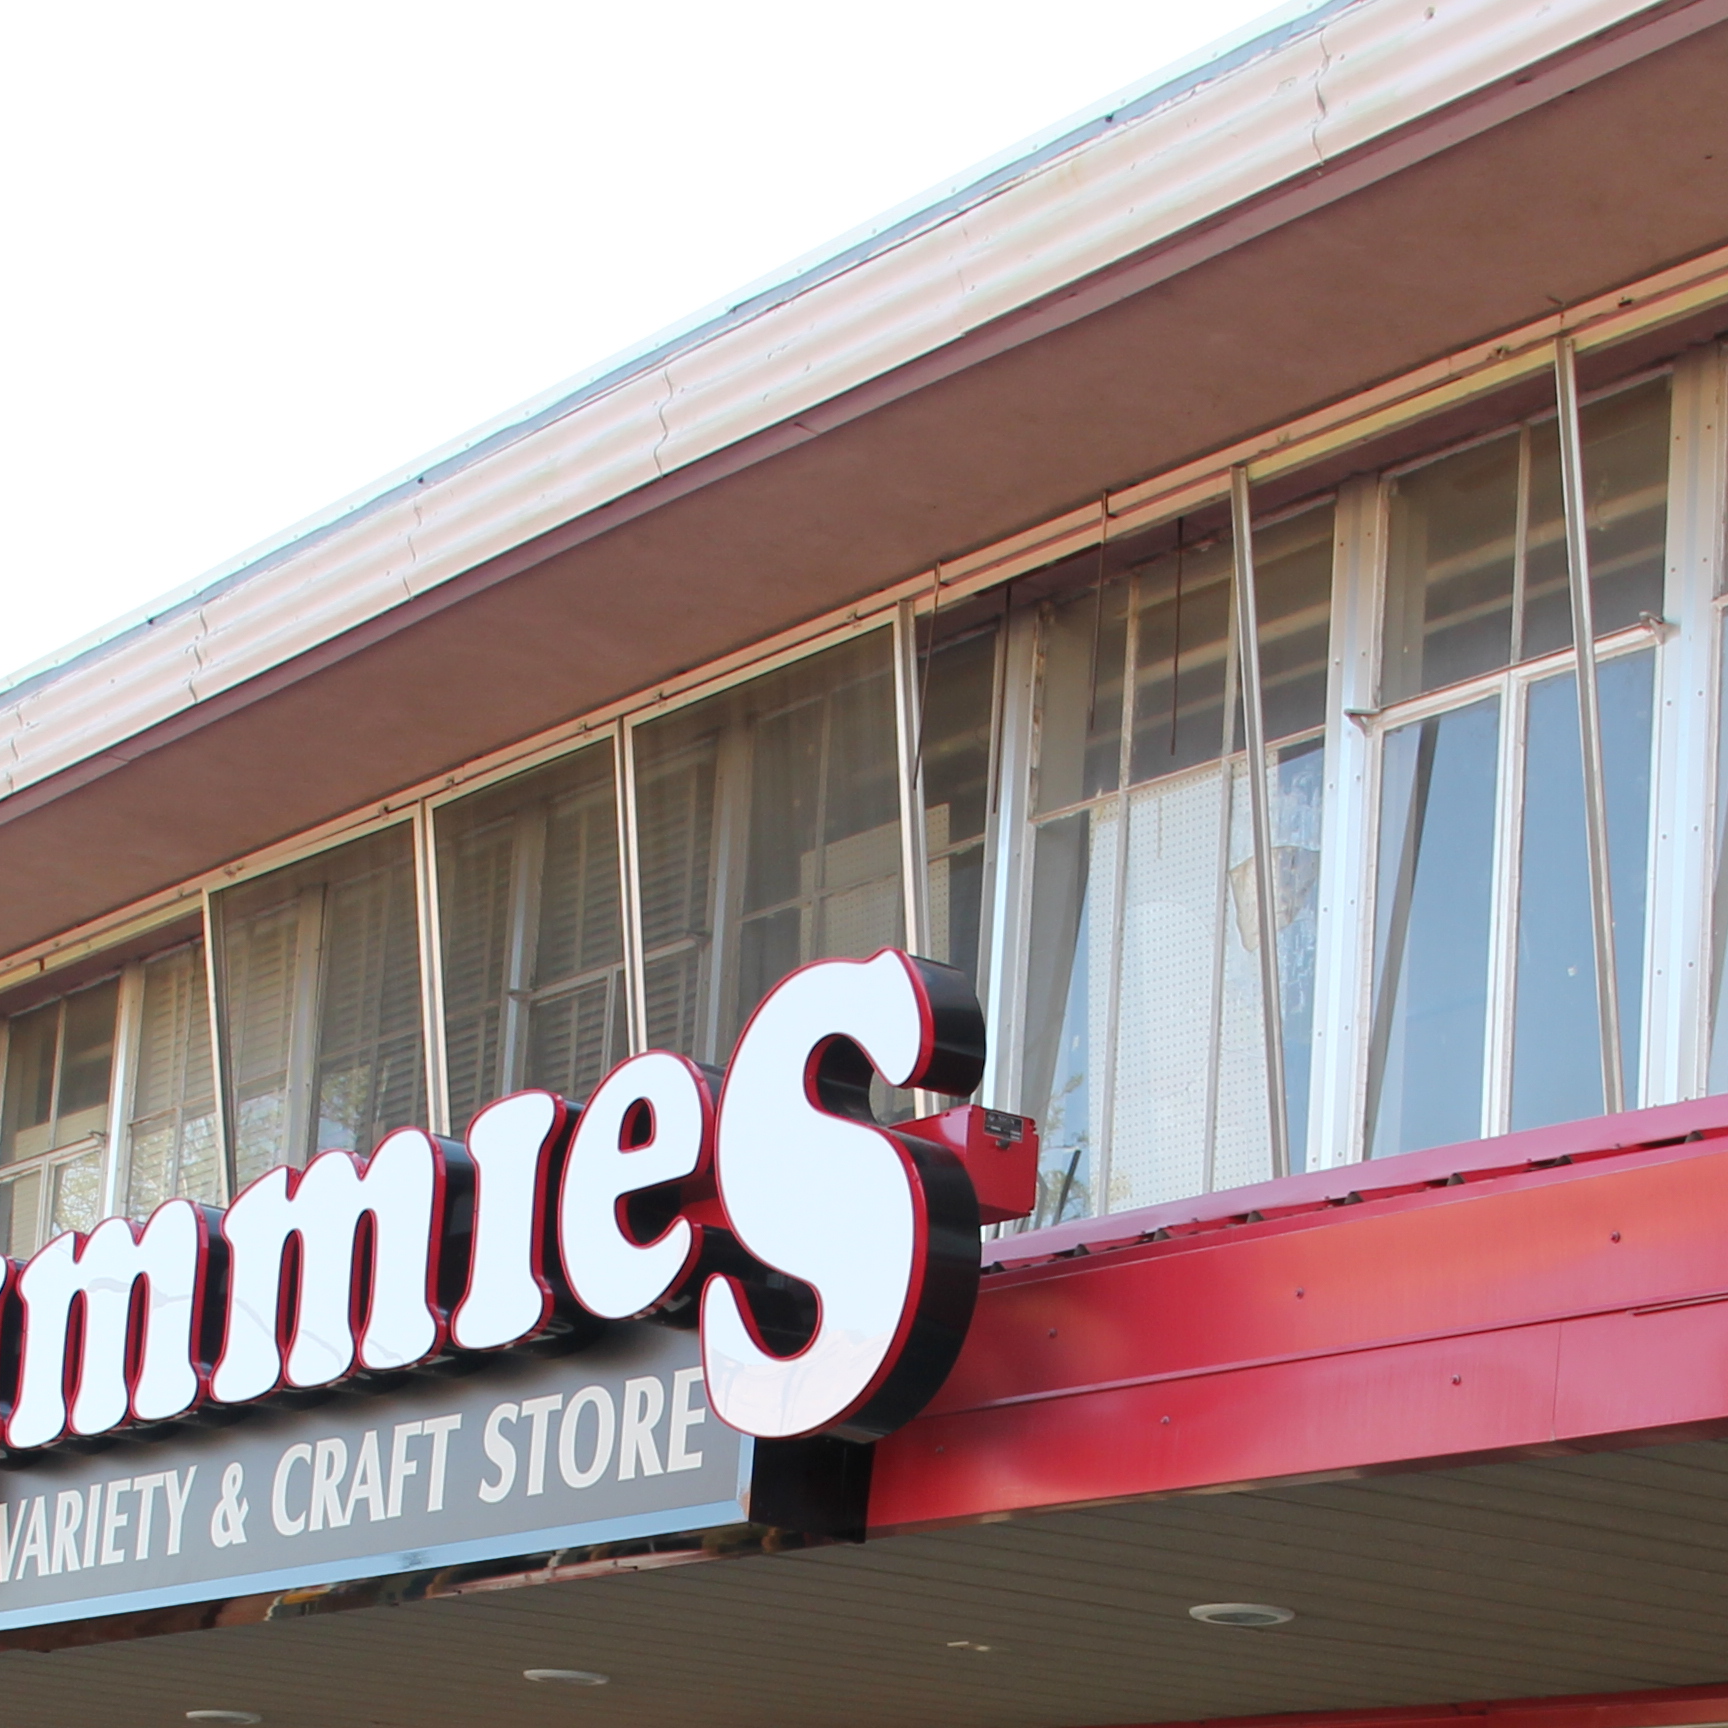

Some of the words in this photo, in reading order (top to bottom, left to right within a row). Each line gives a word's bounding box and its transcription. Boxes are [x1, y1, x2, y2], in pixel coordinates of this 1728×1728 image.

[211, 1462, 249, 1548] &
[273, 1413, 462, 1537] CRAFT
[478, 1366, 706, 1503] STORE
